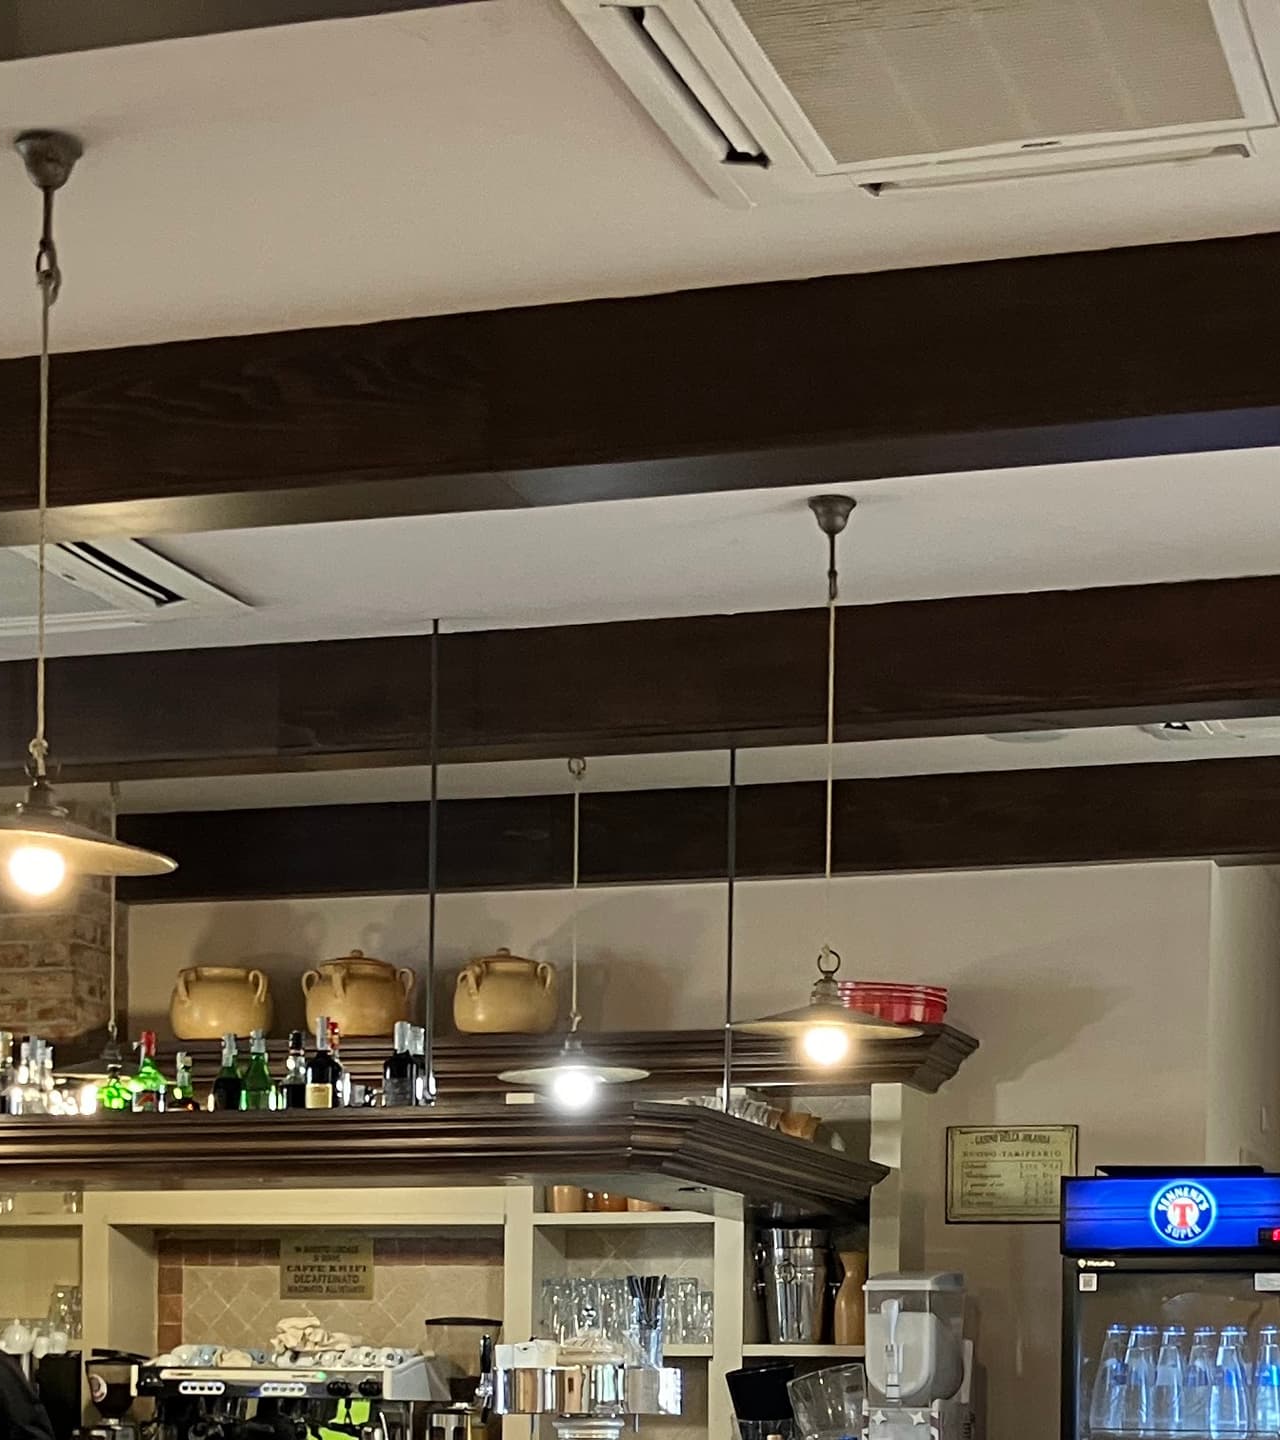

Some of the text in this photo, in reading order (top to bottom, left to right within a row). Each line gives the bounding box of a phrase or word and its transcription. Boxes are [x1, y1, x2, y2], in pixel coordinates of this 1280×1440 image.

[1157, 1186, 1210, 1211] TENNENT'S
[1173, 1203, 1194, 1229] T
[1165, 1223, 1202, 1239] SUPER
